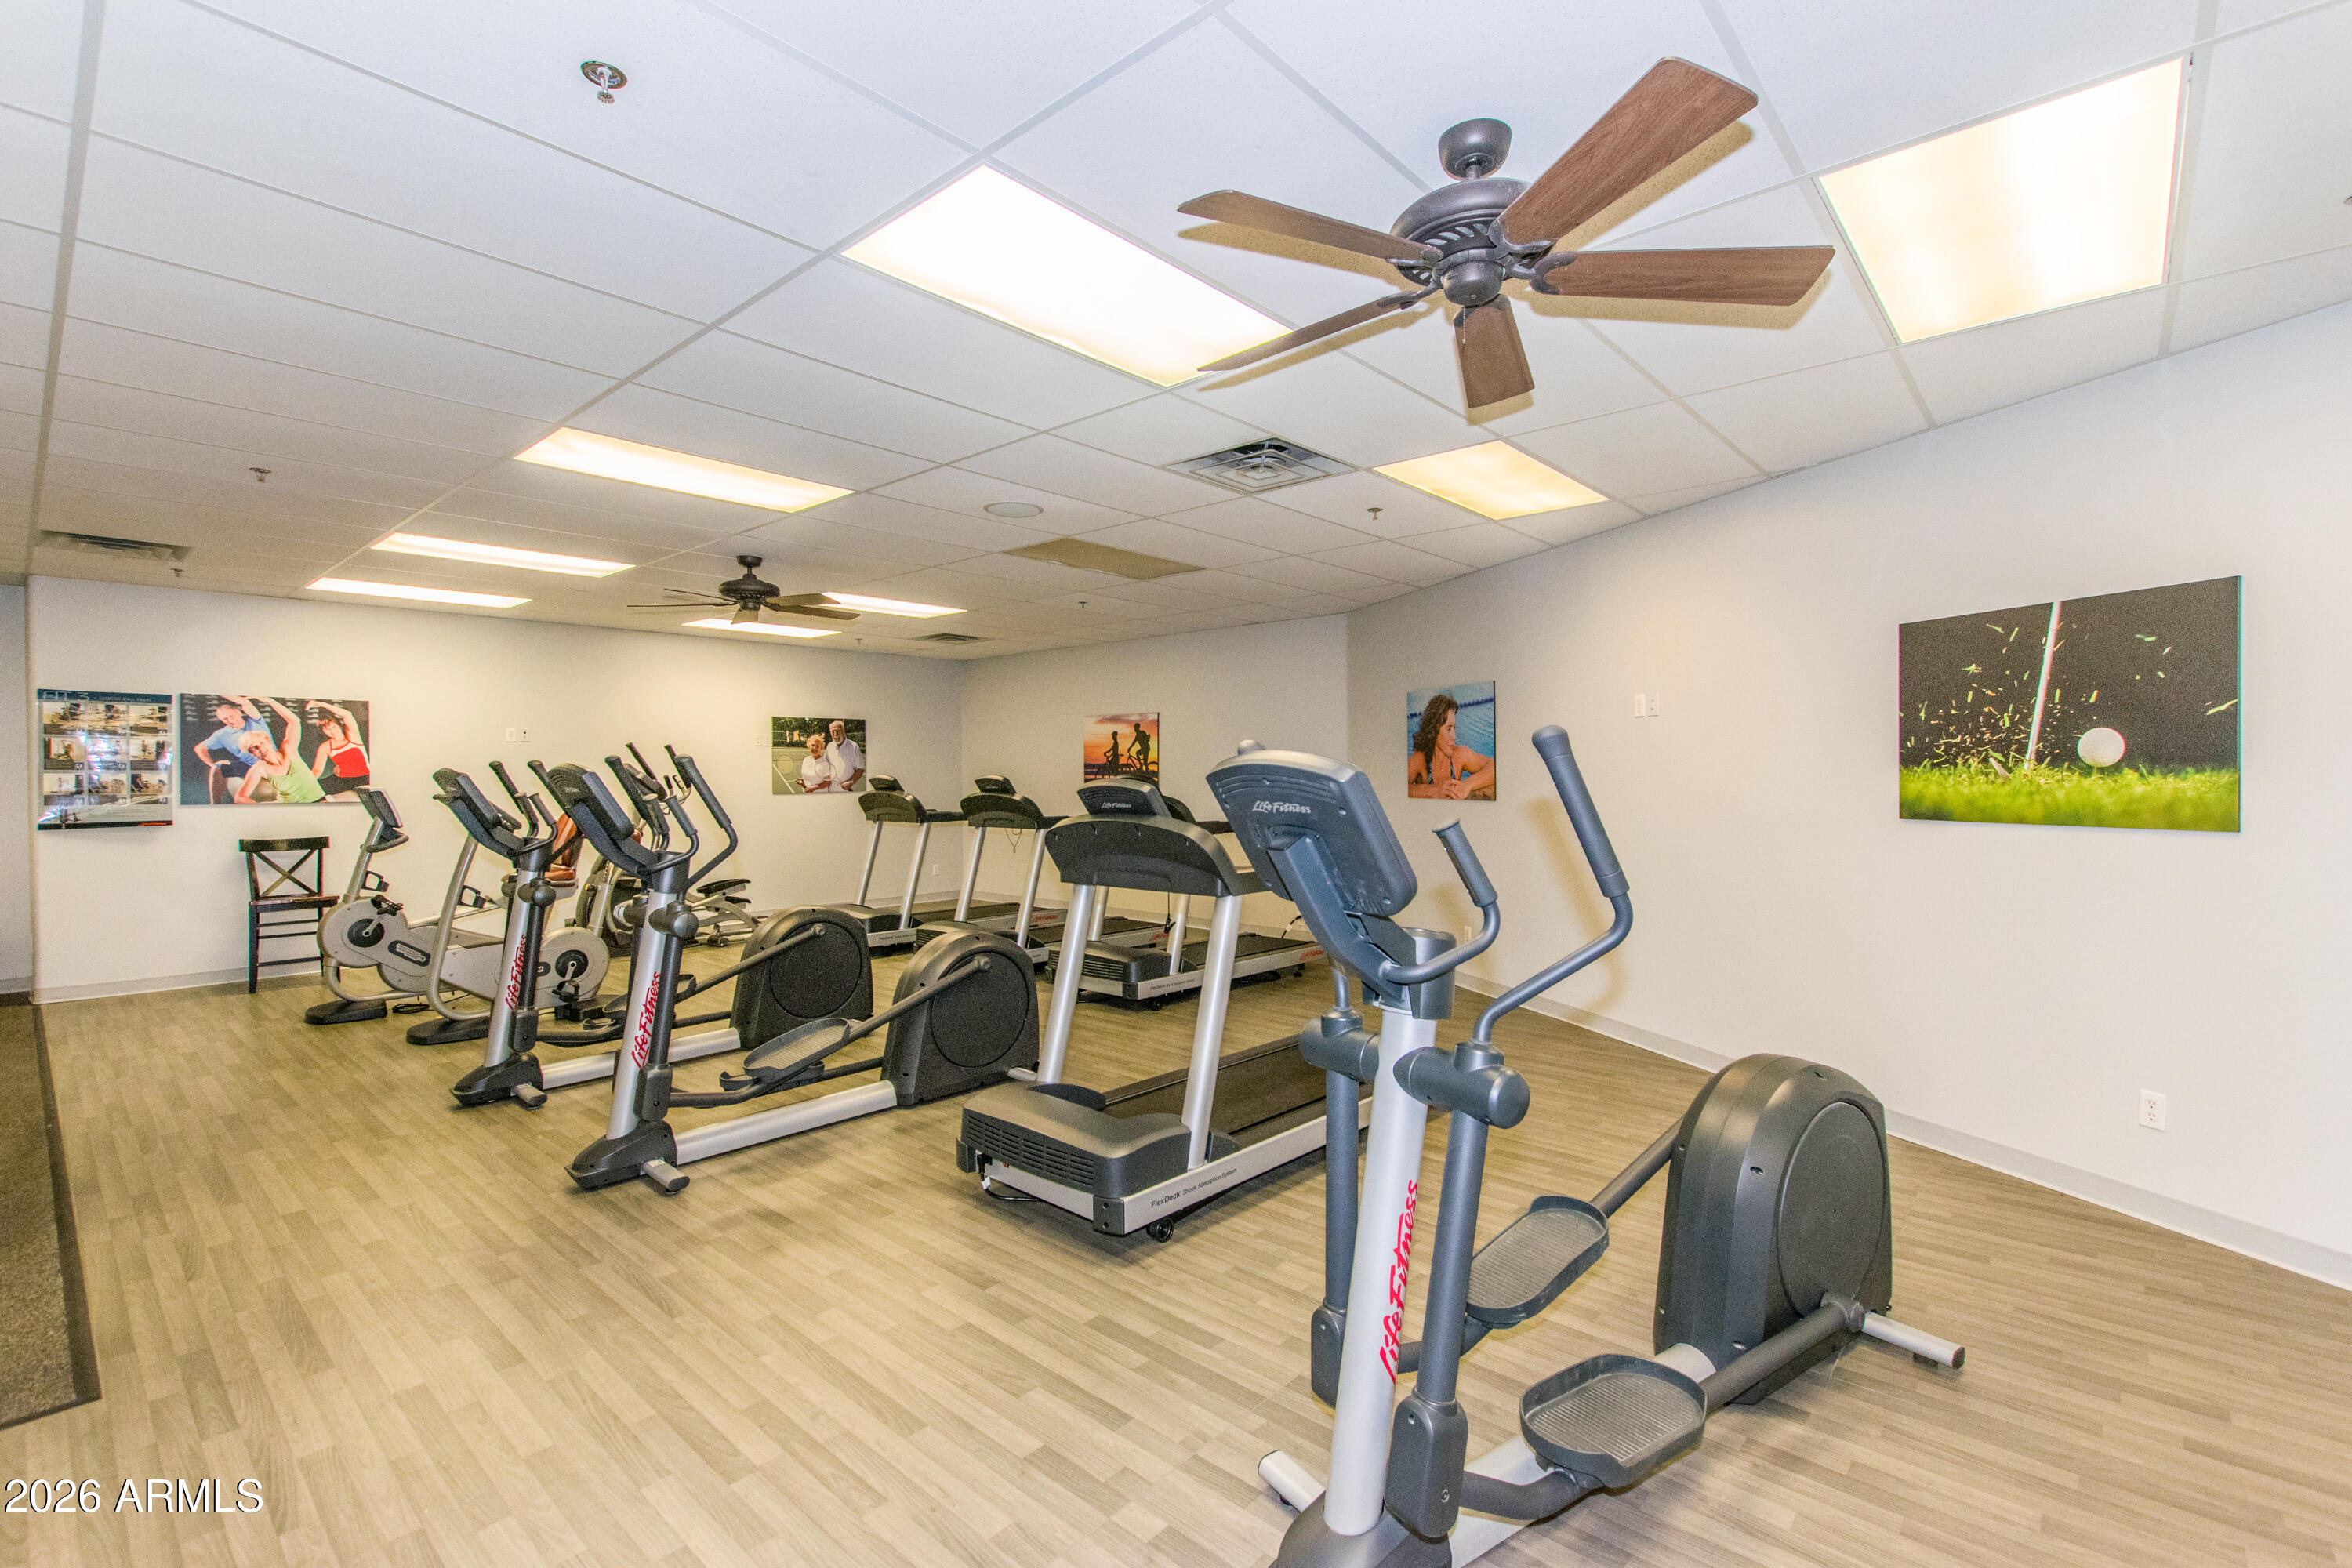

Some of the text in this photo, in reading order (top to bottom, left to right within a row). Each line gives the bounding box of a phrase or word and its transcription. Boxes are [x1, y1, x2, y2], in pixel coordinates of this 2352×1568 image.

[1151, 1167, 1237, 1209] FlexDeck Shock Absorption System
